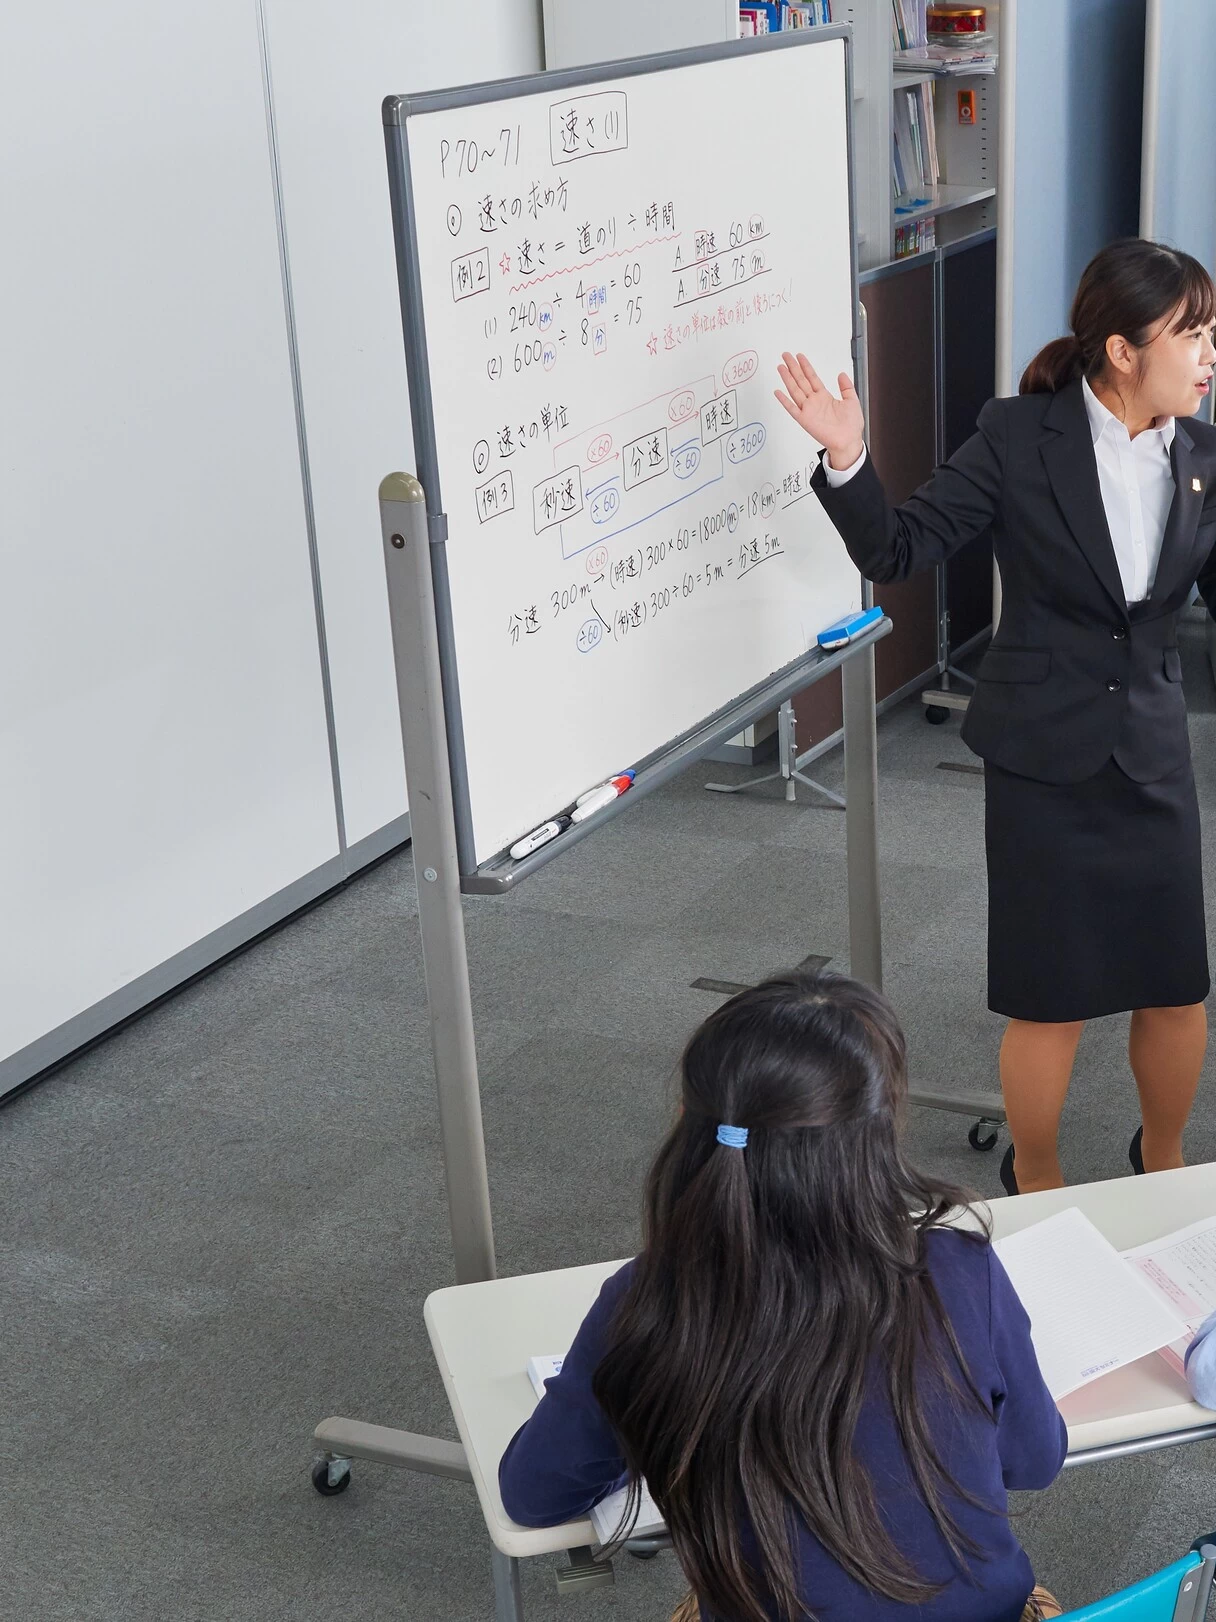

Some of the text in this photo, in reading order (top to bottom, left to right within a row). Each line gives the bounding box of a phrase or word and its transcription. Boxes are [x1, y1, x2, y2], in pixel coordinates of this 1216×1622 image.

[477, 176, 569, 232] 速さの求め方
[456, 259, 486, 292] 例2
[700, 261, 722, 290] 分速
[485, 318, 497, 339] (1)
[487, 357, 503, 380] (2)
[498, 405, 569, 458] 速さの単位
[705, 400, 734, 433] 時速
[630, 440, 663, 478] 分速
[481, 481, 510, 513] 例3
[540, 477, 576, 520] 秒速
[507, 605, 541, 646] 分速
